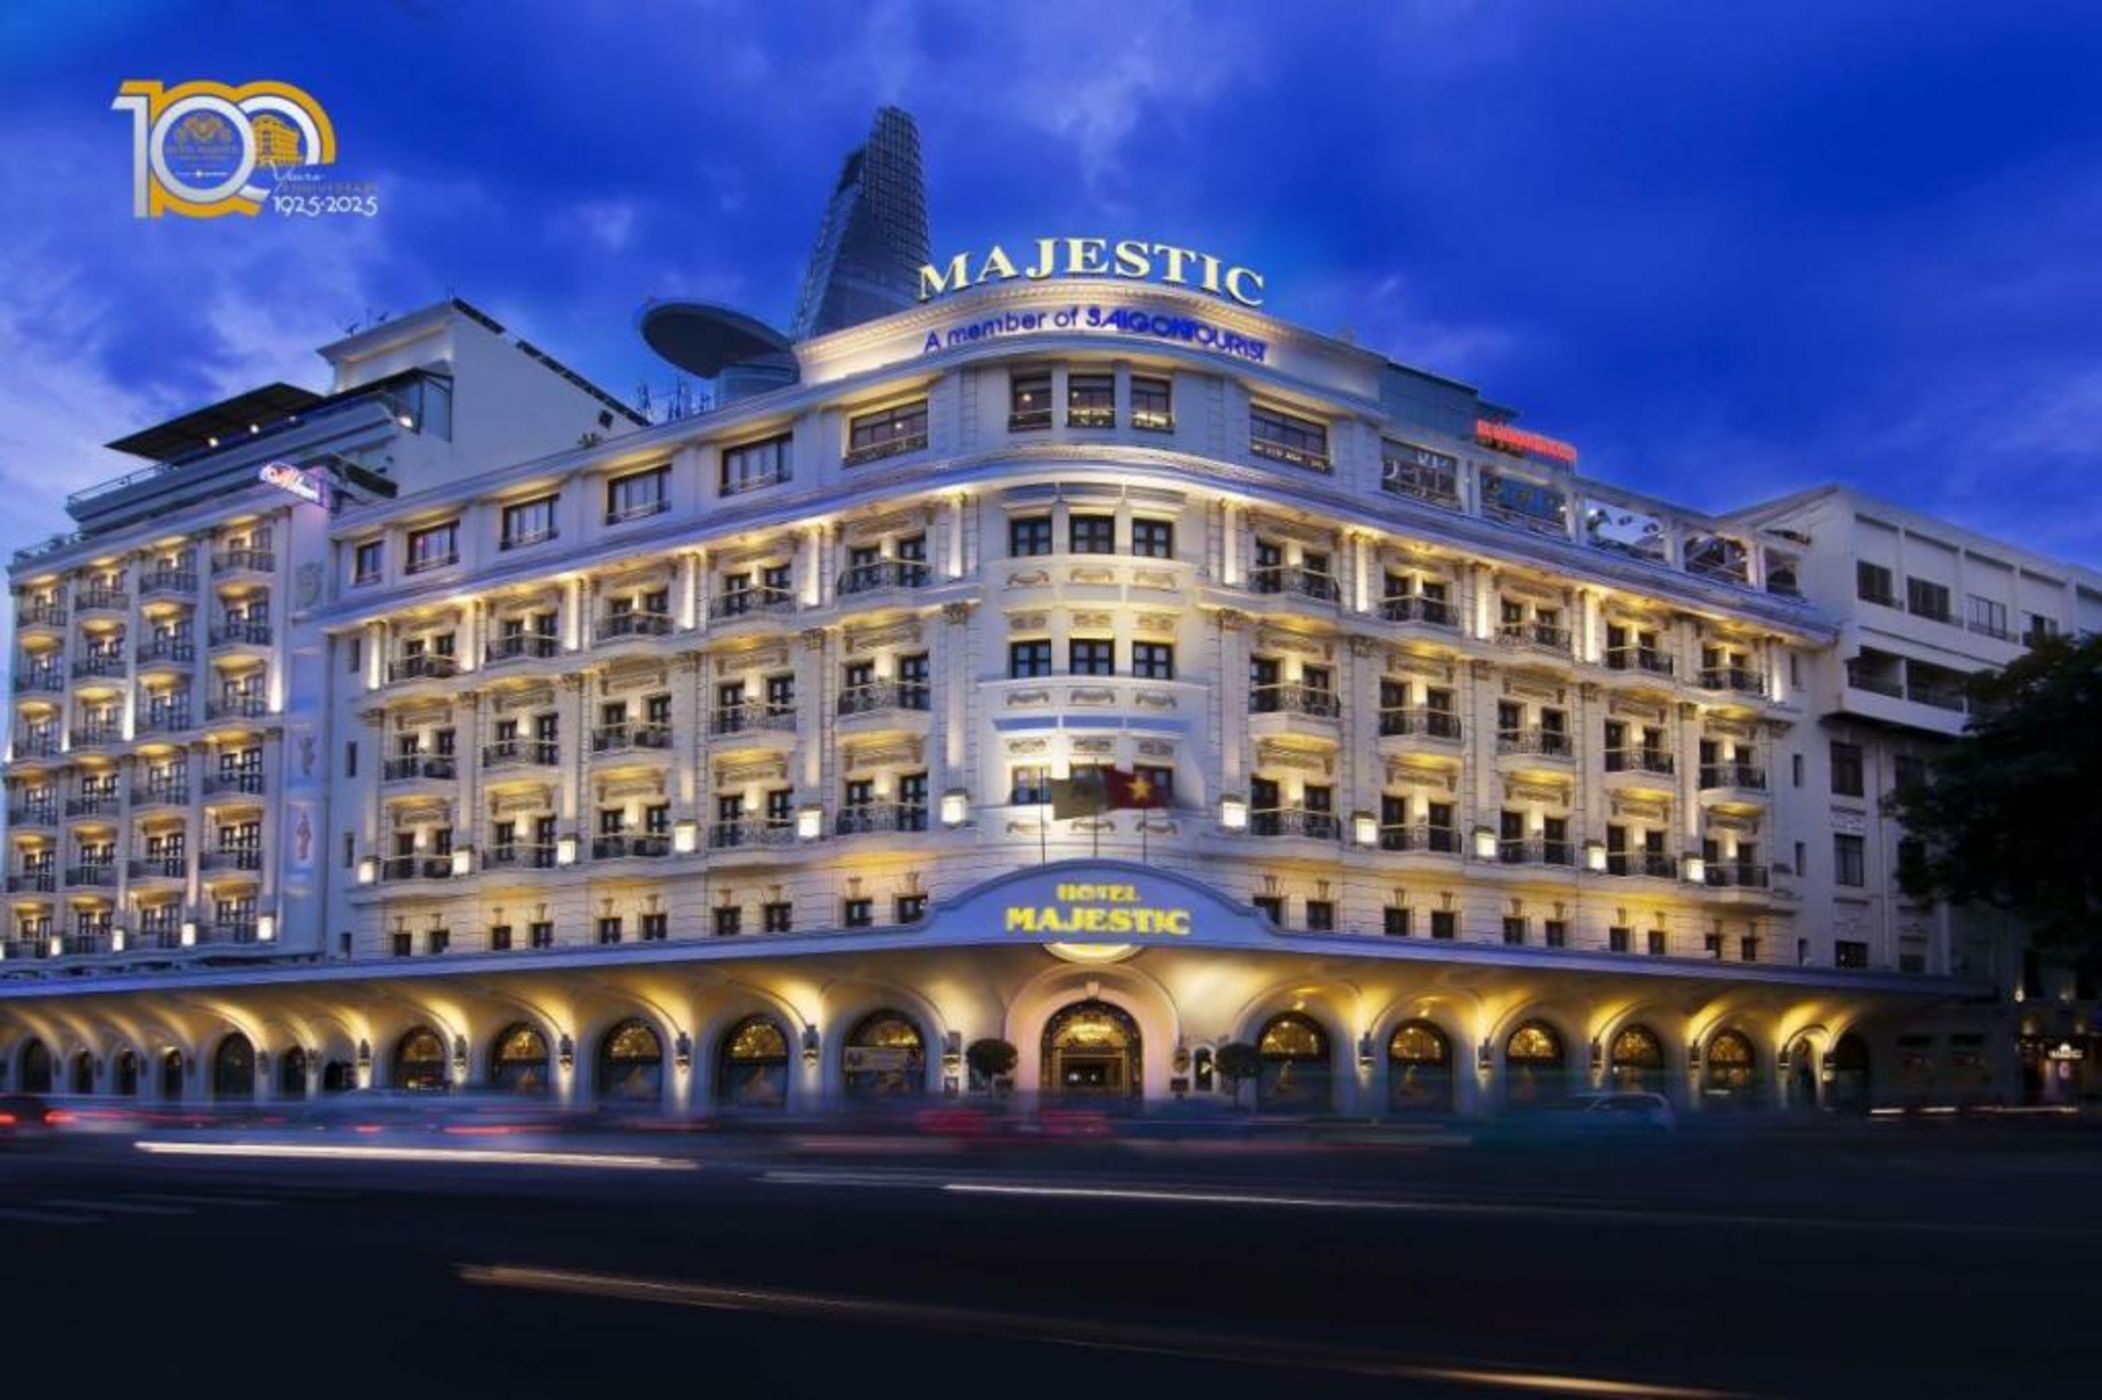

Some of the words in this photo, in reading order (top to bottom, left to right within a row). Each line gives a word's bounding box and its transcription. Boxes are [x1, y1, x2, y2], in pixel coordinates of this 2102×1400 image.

[919, 237, 1265, 305] MAJESTIC
[924, 331, 941, 353] A
[947, 310, 1047, 346] member
[1054, 305, 1079, 328] of
[1086, 305, 1268, 362] SAIGONTOURIST
[1057, 883, 1141, 902] HOTEL
[1006, 907, 1191, 935] MAJESTIC
